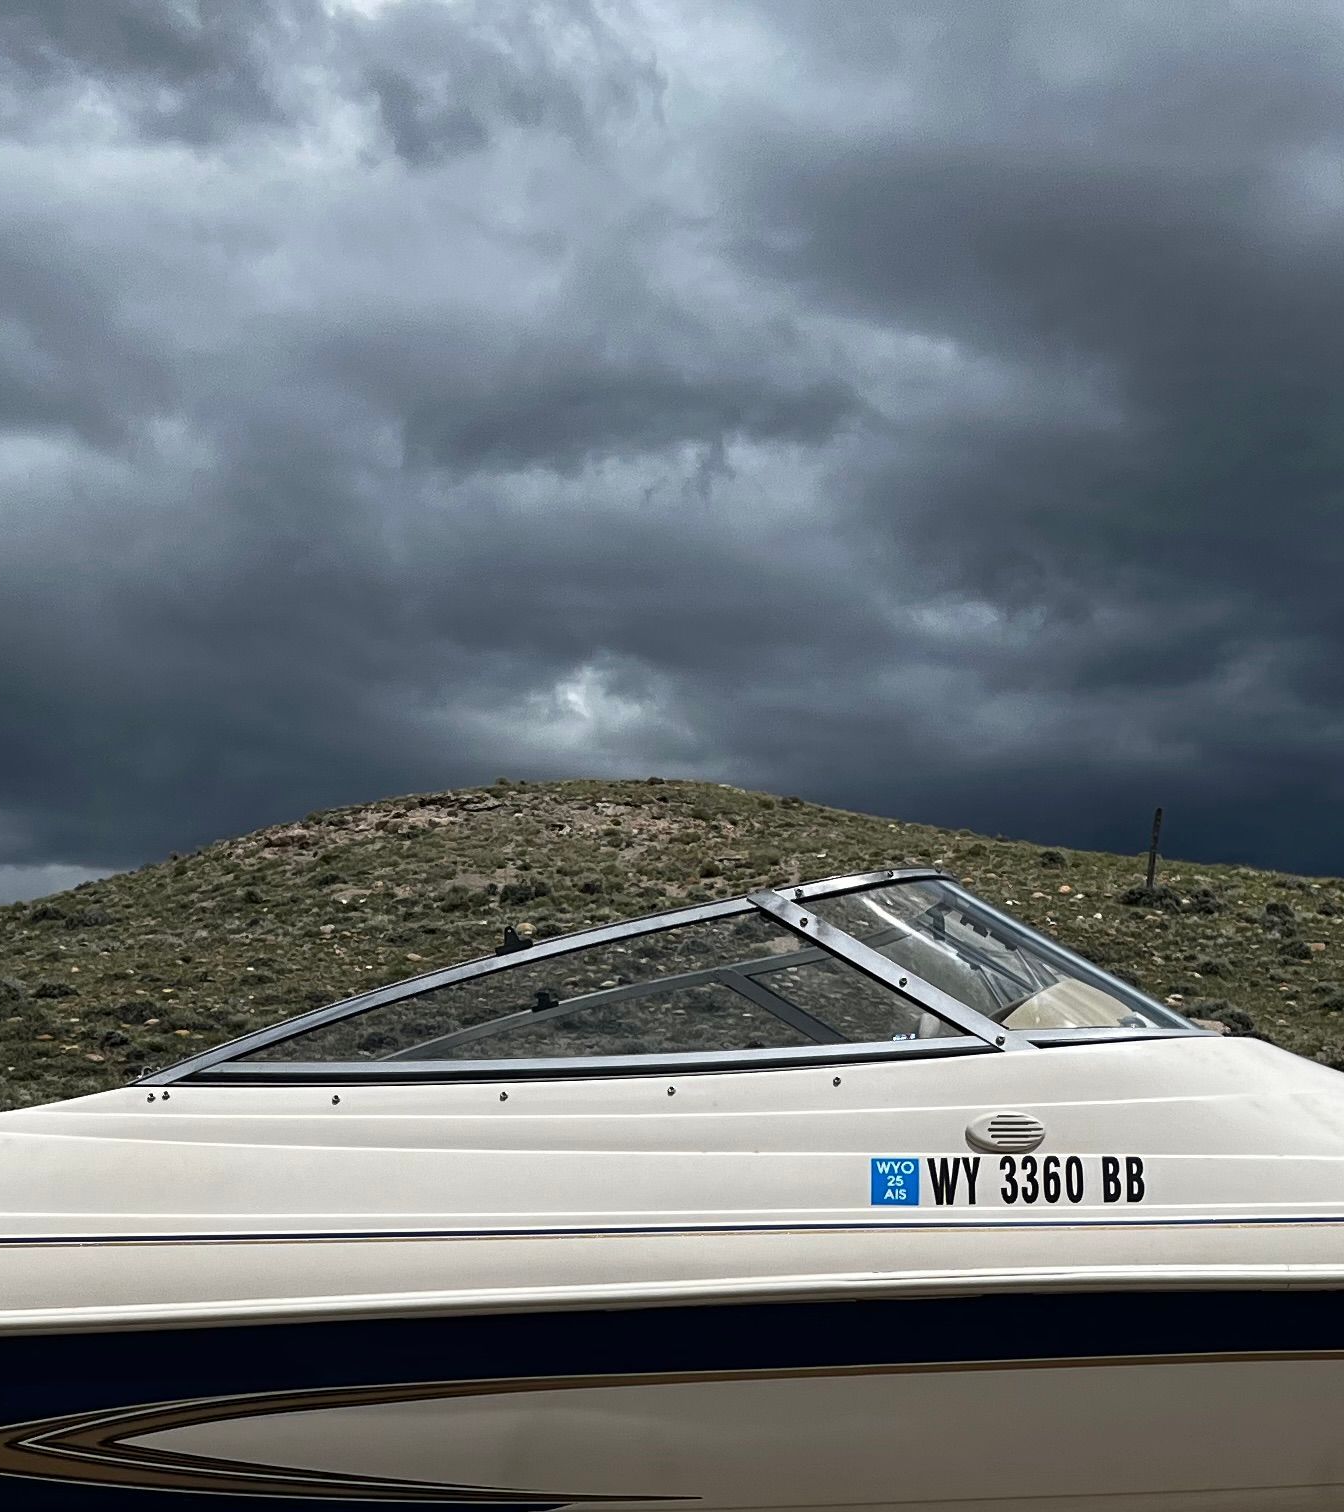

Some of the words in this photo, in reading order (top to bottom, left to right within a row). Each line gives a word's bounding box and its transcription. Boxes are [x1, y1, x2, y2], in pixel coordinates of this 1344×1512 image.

[876, 1161, 915, 1175] WYO
[887, 1176, 904, 1187] 25
[927, 1157, 981, 1206] WY
[999, 1155, 1084, 1204] 3360
[1102, 1156, 1145, 1203] BB
[883, 1189, 907, 1200] AIS
